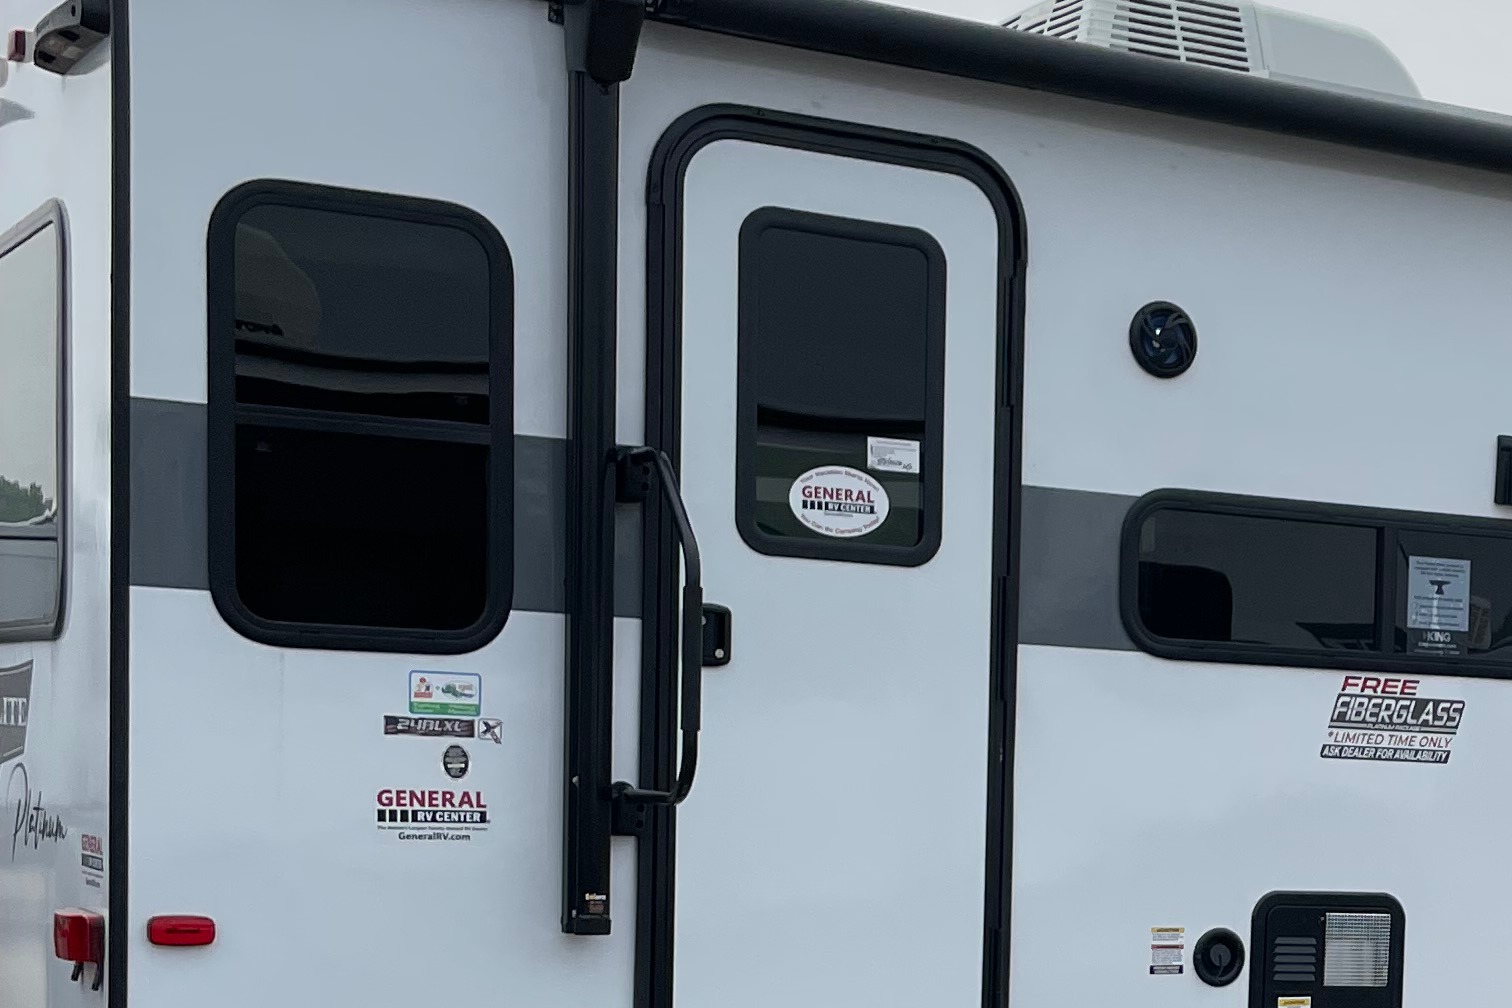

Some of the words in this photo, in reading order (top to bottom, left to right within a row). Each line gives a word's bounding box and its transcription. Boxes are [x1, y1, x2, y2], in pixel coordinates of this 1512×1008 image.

[802, 485, 875, 503] GENERAL
[828, 502, 839, 511] RV
[840, 503, 871, 514] CENTER
[1341, 675, 1420, 696] FREE
[0, 696, 27, 726] ITE
[1332, 695, 1465, 727] FIBERGLASS
[1388, 734, 1418, 747] TIME
[1419, 736, 1453, 749] ONLY
[1322, 745, 1341, 758] ASK
[1341, 746, 1376, 759] DEALER
[1376, 748, 1394, 760] FOR
[1394, 749, 1448, 763] AVAILABILITY
[377, 789, 487, 808] GENERAL
[7, 762, 68, 862] Platinum
[417, 811, 433, 822] RV
[436, 811, 481, 822] CENTER
[398, 832, 471, 841] GeneralRV.com
